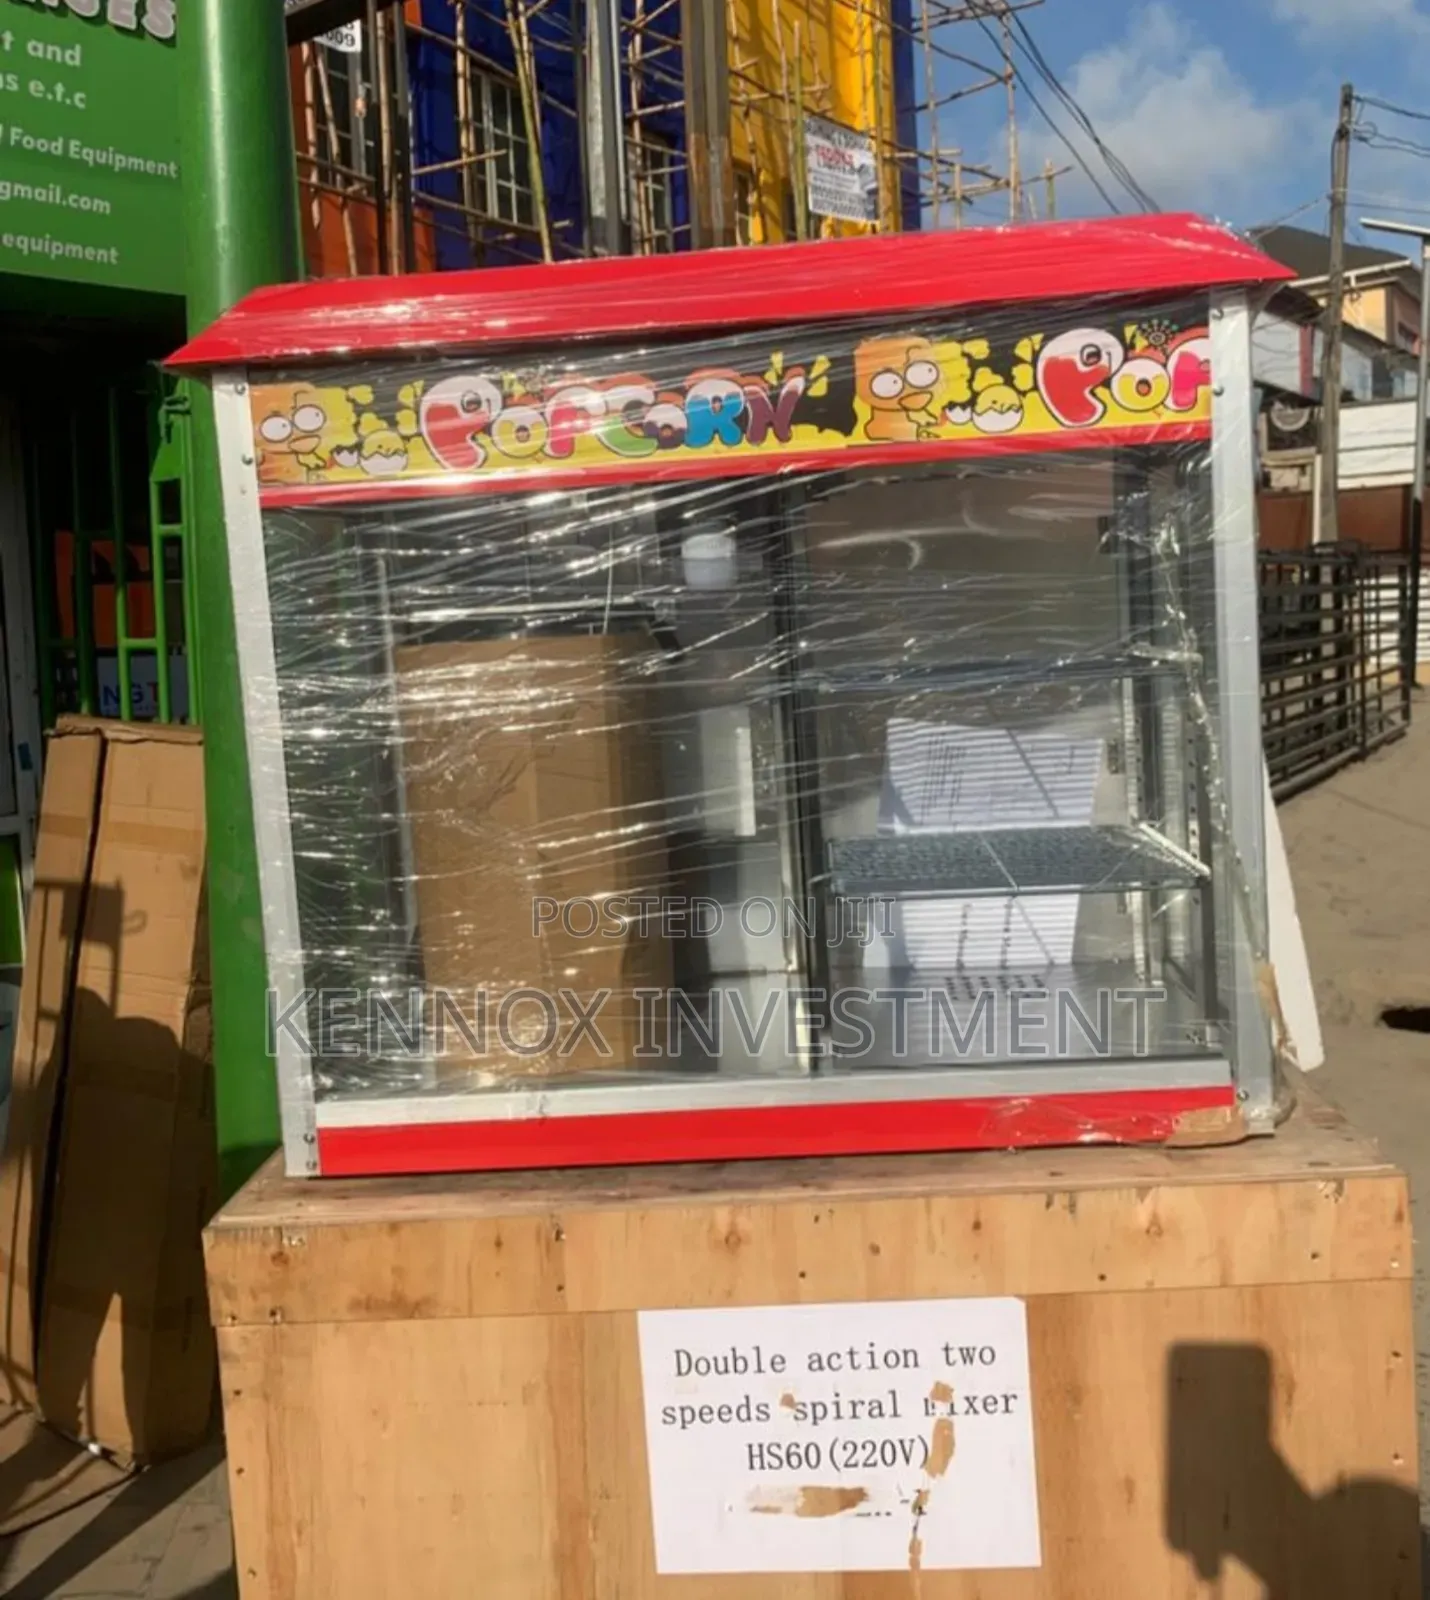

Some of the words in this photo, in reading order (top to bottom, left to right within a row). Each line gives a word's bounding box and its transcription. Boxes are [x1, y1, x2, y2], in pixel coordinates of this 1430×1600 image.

[27, 40, 82, 67] and
[29, 79, 87, 109] e.t.c
[10, 126, 64, 156] Food
[69, 139, 179, 179] Equipment
[2, 233, 119, 265] equipment
[674, 1346, 788, 1378] Double
[807, 1342, 920, 1373] action
[941, 1343, 997, 1368] two
[661, 1395, 772, 1430] speeds
[792, 1390, 903, 1427] spiral
[747, 1434, 931, 1473] HS60(220V)
